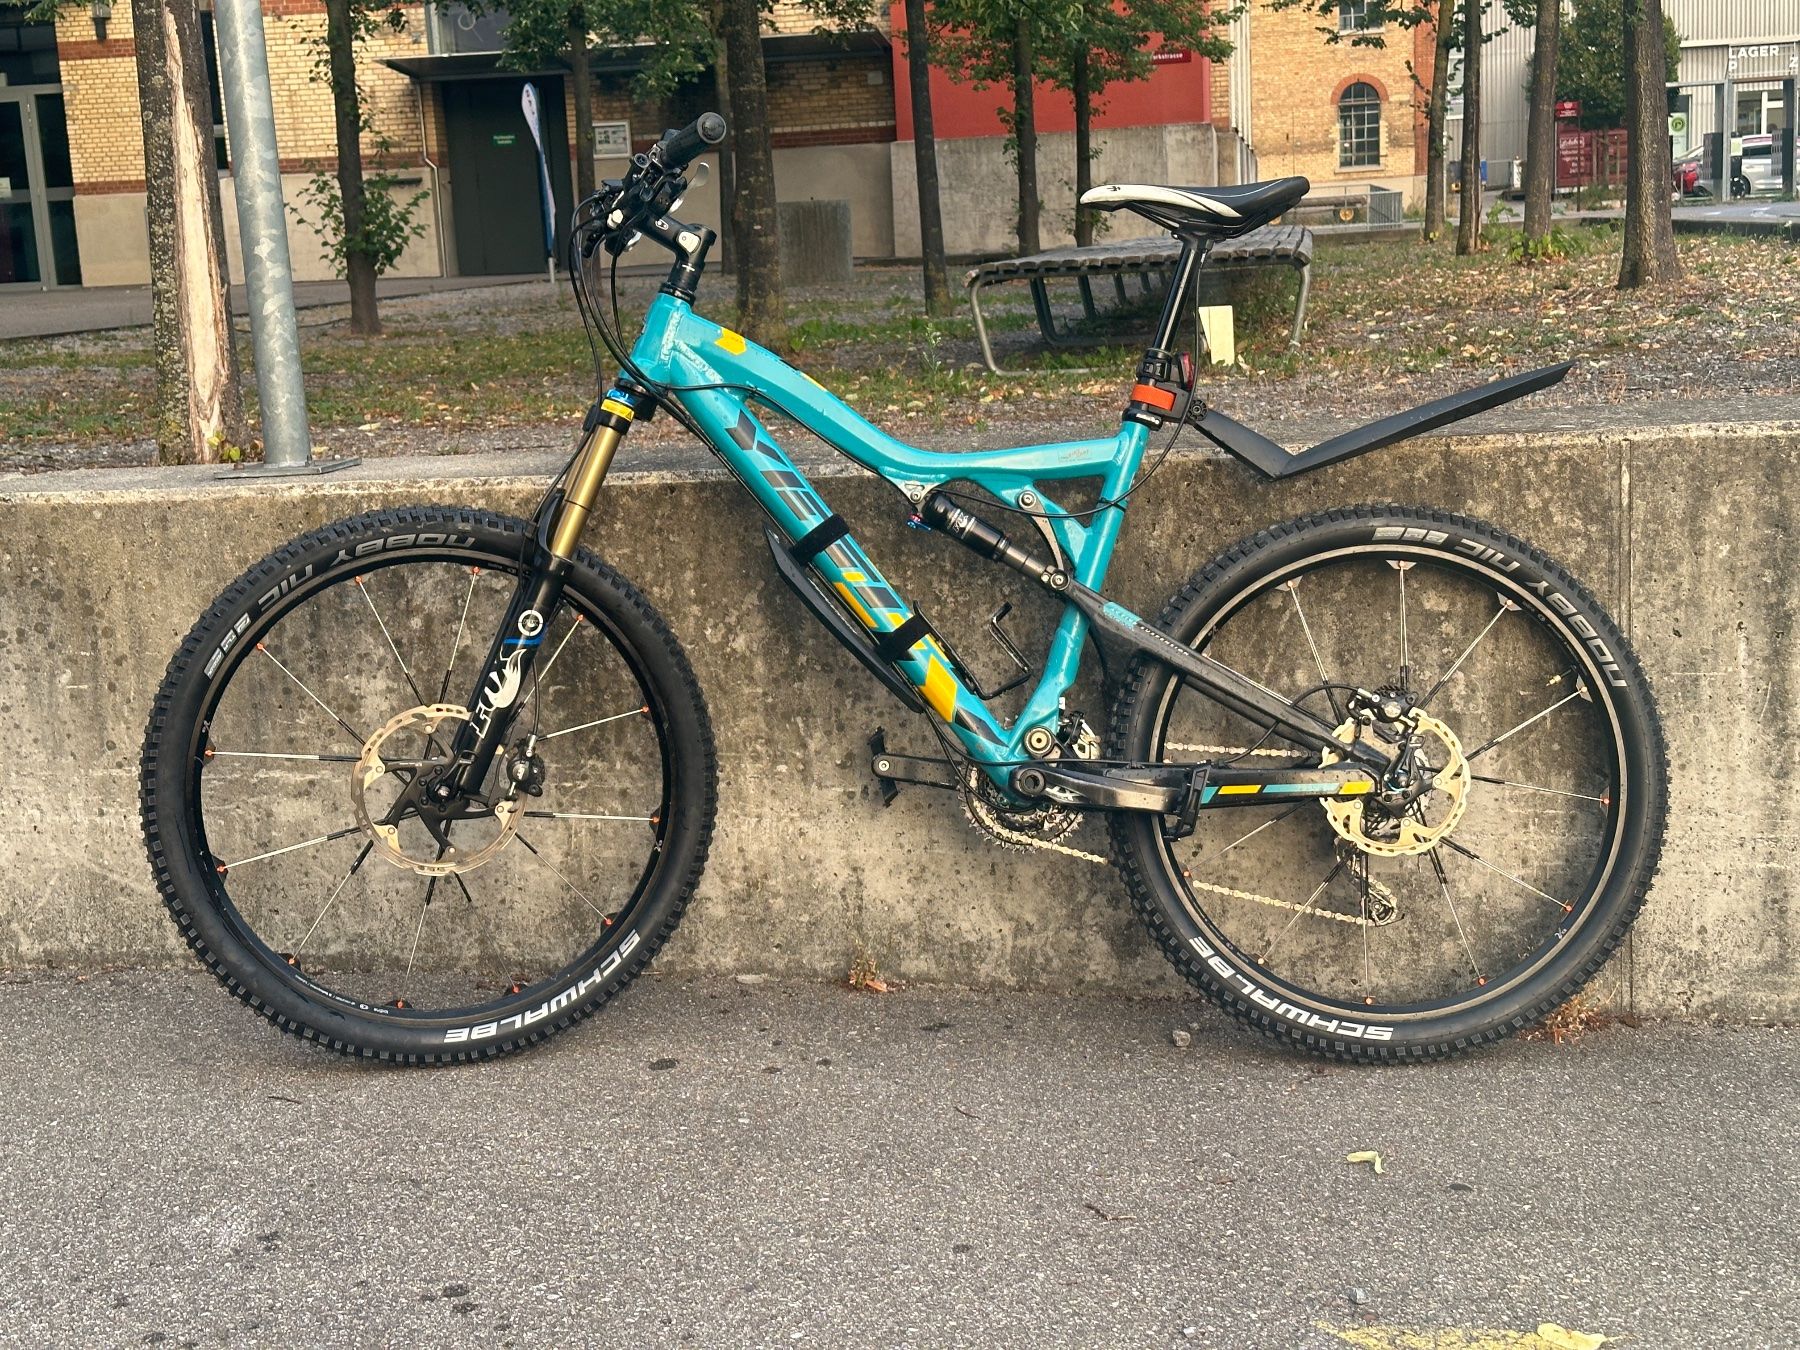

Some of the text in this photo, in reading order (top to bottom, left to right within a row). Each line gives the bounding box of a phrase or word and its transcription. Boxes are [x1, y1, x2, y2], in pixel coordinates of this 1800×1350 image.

[1729, 45, 1779, 58] LAGER
[258, 564, 312, 612] NIC
[1454, 538, 1521, 573] NIC
[469, 646, 527, 739] FOX
[443, 929, 641, 1043] SCHWALBE
[1189, 936, 1394, 1041] SCHWALBE
